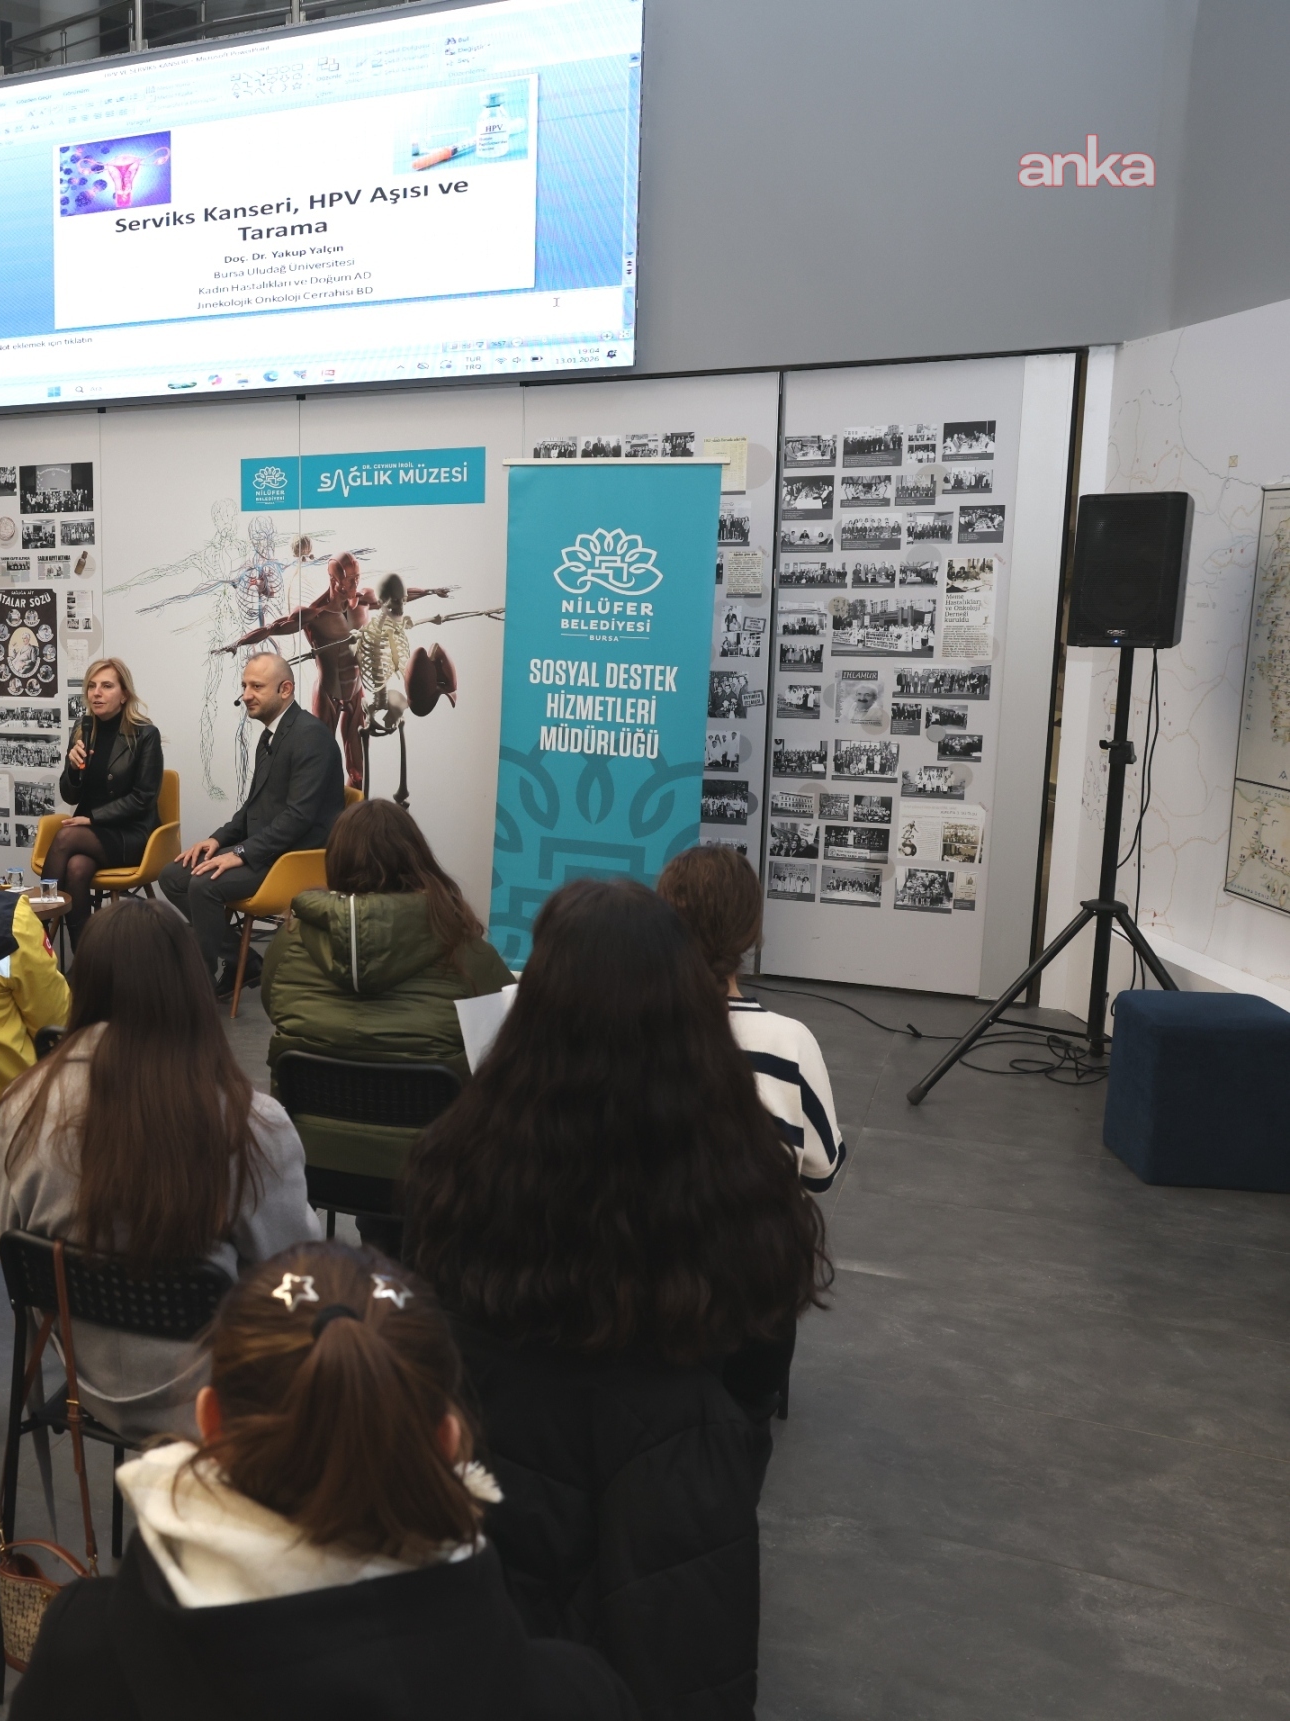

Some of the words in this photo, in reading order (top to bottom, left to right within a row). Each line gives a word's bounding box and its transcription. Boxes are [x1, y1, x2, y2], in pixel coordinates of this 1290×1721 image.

[485, 124, 503, 132] HPV
[115, 210, 195, 233] Serviks
[204, 197, 299, 223] Kanseri,
[310, 189, 361, 210] HPV
[370, 185, 428, 205] Aşısı
[438, 180, 469, 195] ve
[238, 221, 327, 241] Tarama
[224, 252, 248, 264] Doç.
[252, 252, 267, 261] Dr.
[272, 247, 306, 260] Yakup
[310, 244, 344, 256] Yalçın
[213, 269, 245, 279] Bursa
[247, 264, 286, 277] Uludağ
[289, 258, 355, 273] Üniversitesi
[198, 284, 229, 295] Kadın
[231, 278, 292, 292] Hastalıkları
[293, 278, 308, 286] ve
[310, 272, 352, 285] Doğum
[354, 271, 372, 280] AD
[255, 293, 301, 305] Onkoloji
[303, 288, 354, 300] Cerrahisi
[356, 286, 374, 296] BD
[12, 341, 46, 351] eklemek
[48, 339, 62, 348] için
[64, 336, 93, 347] tıklatın
[578, 347, 600, 355] 19:04
[555, 356, 600, 365] 13.01.2026
[318, 465, 393, 497] SAĞLIK
[399, 462, 468, 484] MÜZESİ
[30, 592, 51, 607] SÖZÜ
[561, 598, 654, 617] NİLÜFER
[561, 618, 651, 633] BELEDİYESİ
[589, 634, 620, 642] BURSA
[529, 658, 601, 687] SOSYAL
[605, 662, 678, 693] DESTEK
[546, 691, 656, 725] HİZMETLERİ
[539, 724, 659, 759] MÜDÜRLÜĞÜ
